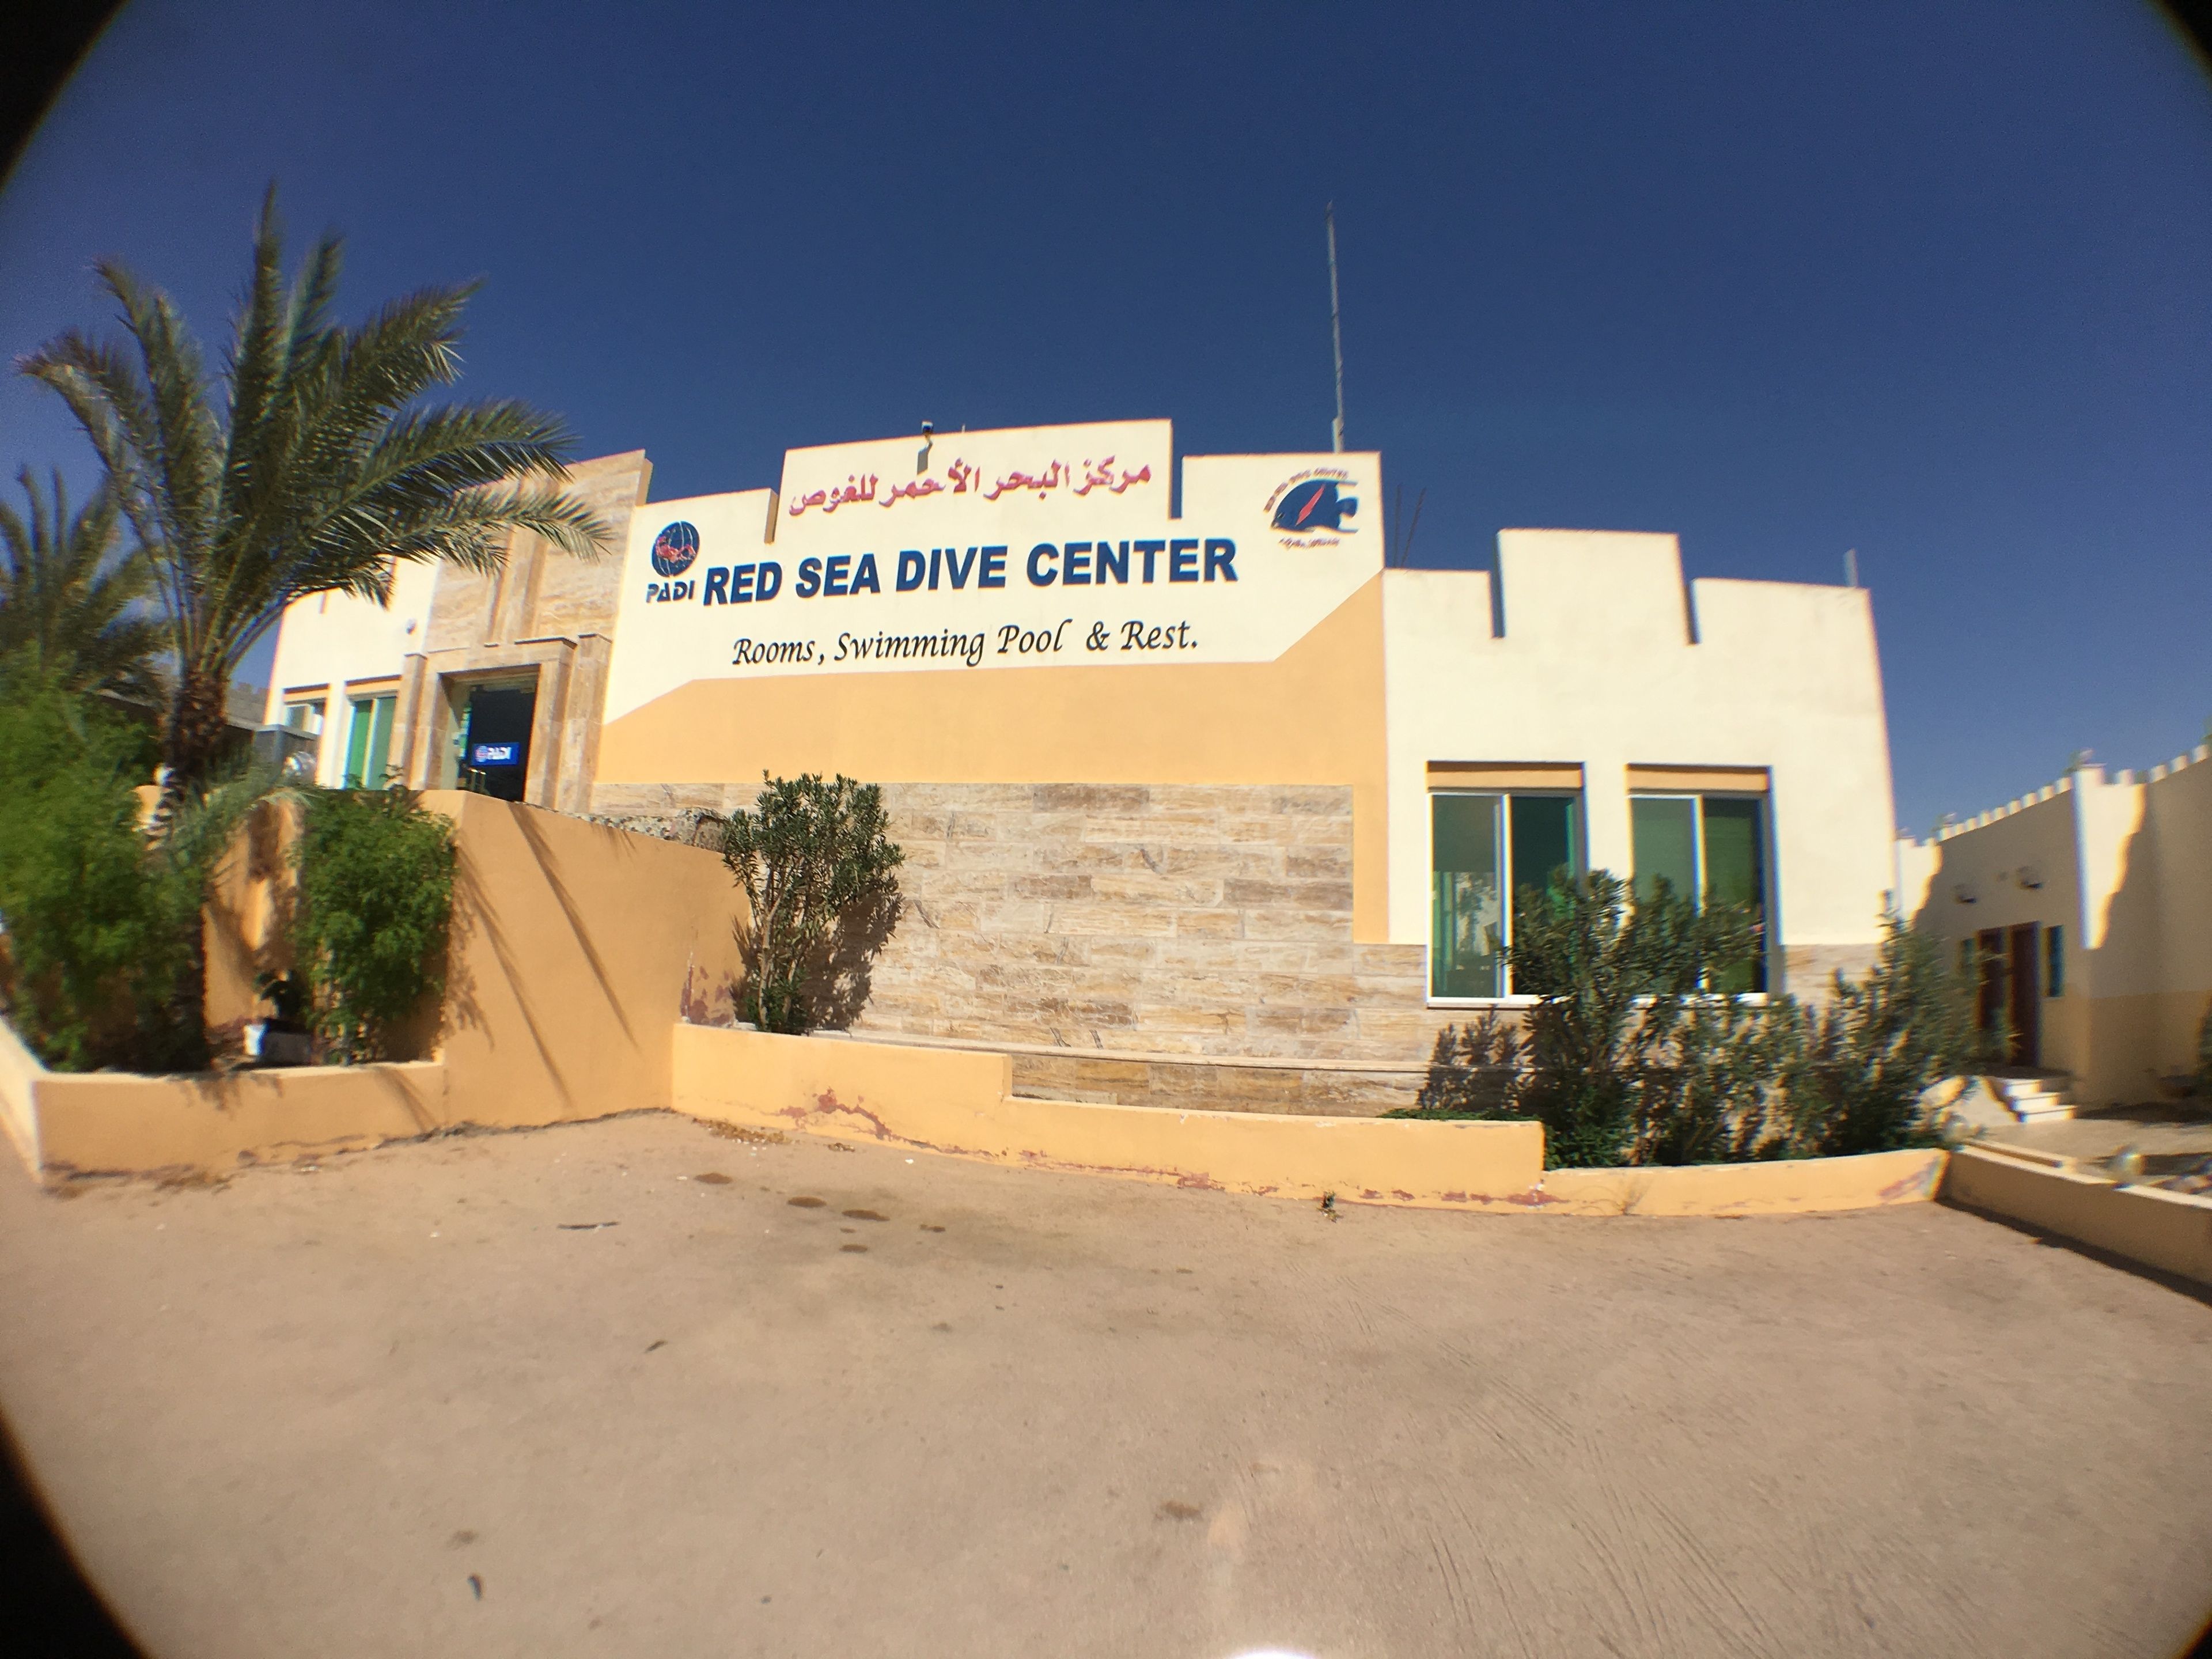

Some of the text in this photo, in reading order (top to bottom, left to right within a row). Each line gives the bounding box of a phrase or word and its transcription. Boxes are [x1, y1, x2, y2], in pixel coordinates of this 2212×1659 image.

[790, 456, 1152, 516] مركز البحر الأحمر للغوص
[646, 580, 695, 603] PADI
[703, 539, 1238, 606] RED SEA DIVE CENTER
[732, 619, 1198, 668] Rooms, Swimming Pool & Rest.
